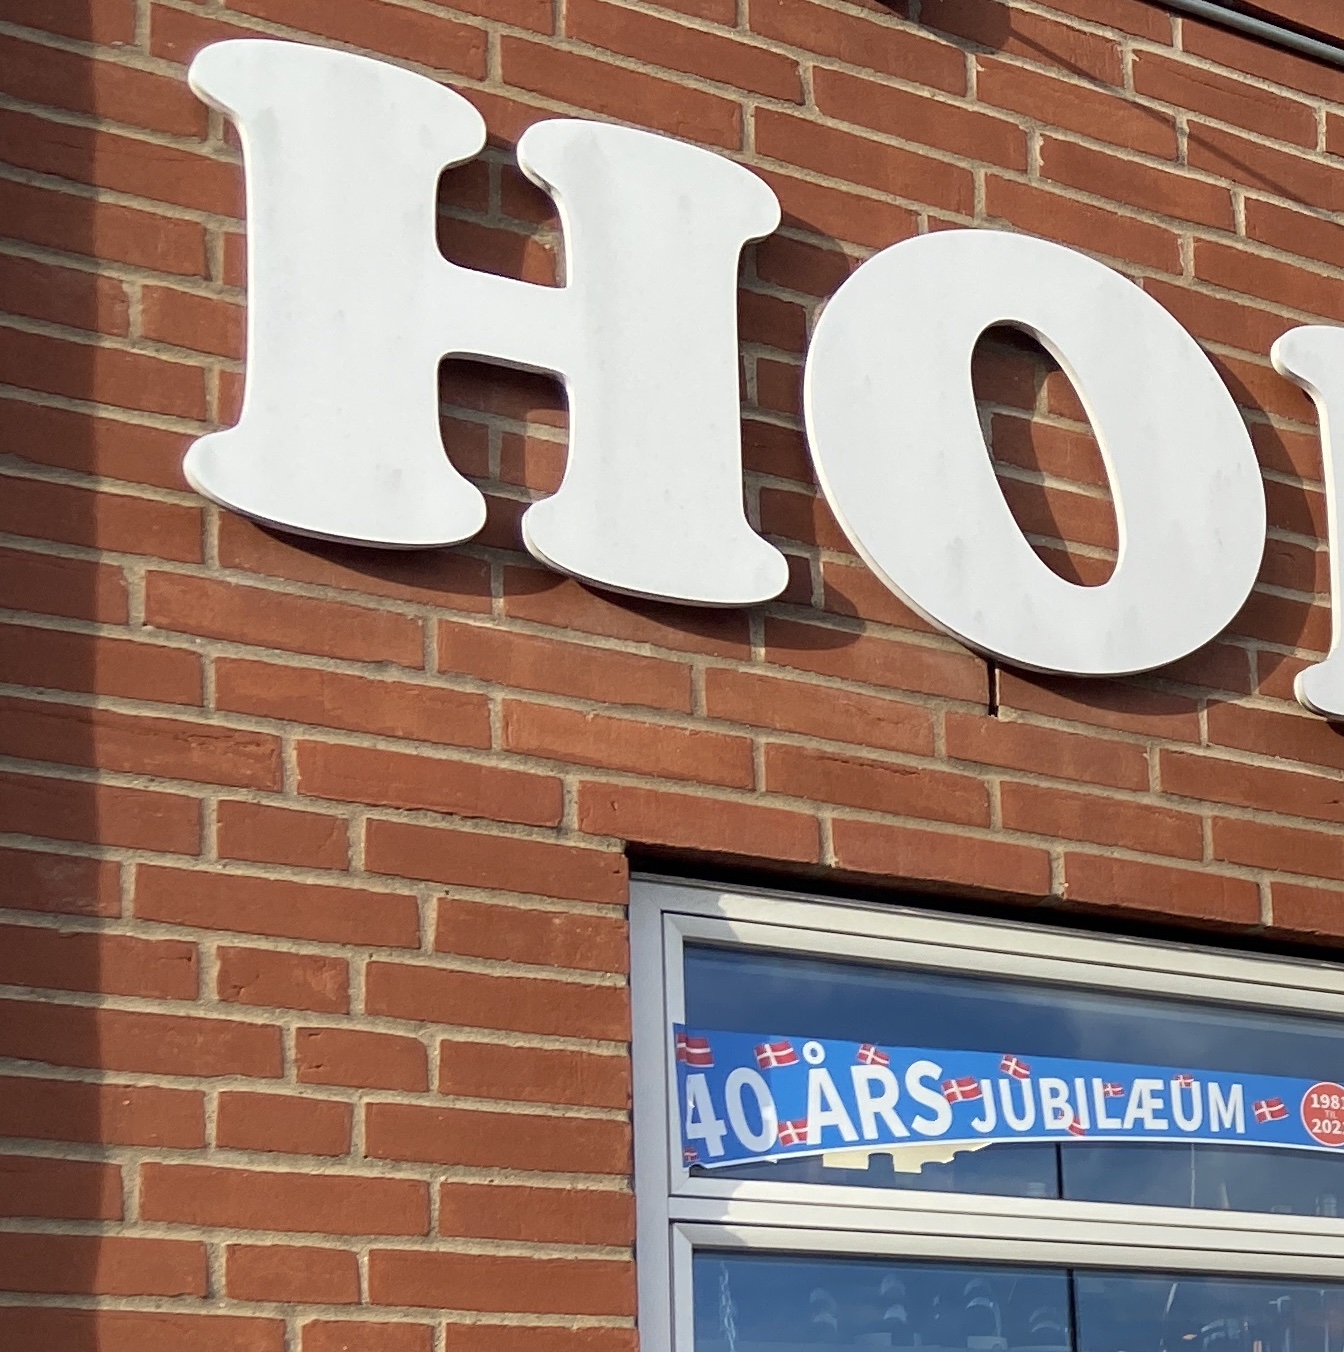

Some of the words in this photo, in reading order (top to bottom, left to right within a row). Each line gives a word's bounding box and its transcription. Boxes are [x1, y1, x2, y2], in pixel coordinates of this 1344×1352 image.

[687, 1066, 777, 1157] 40
[800, 1039, 952, 1144] ÅRS
[970, 1077, 1246, 1134] JUBILÆUM
